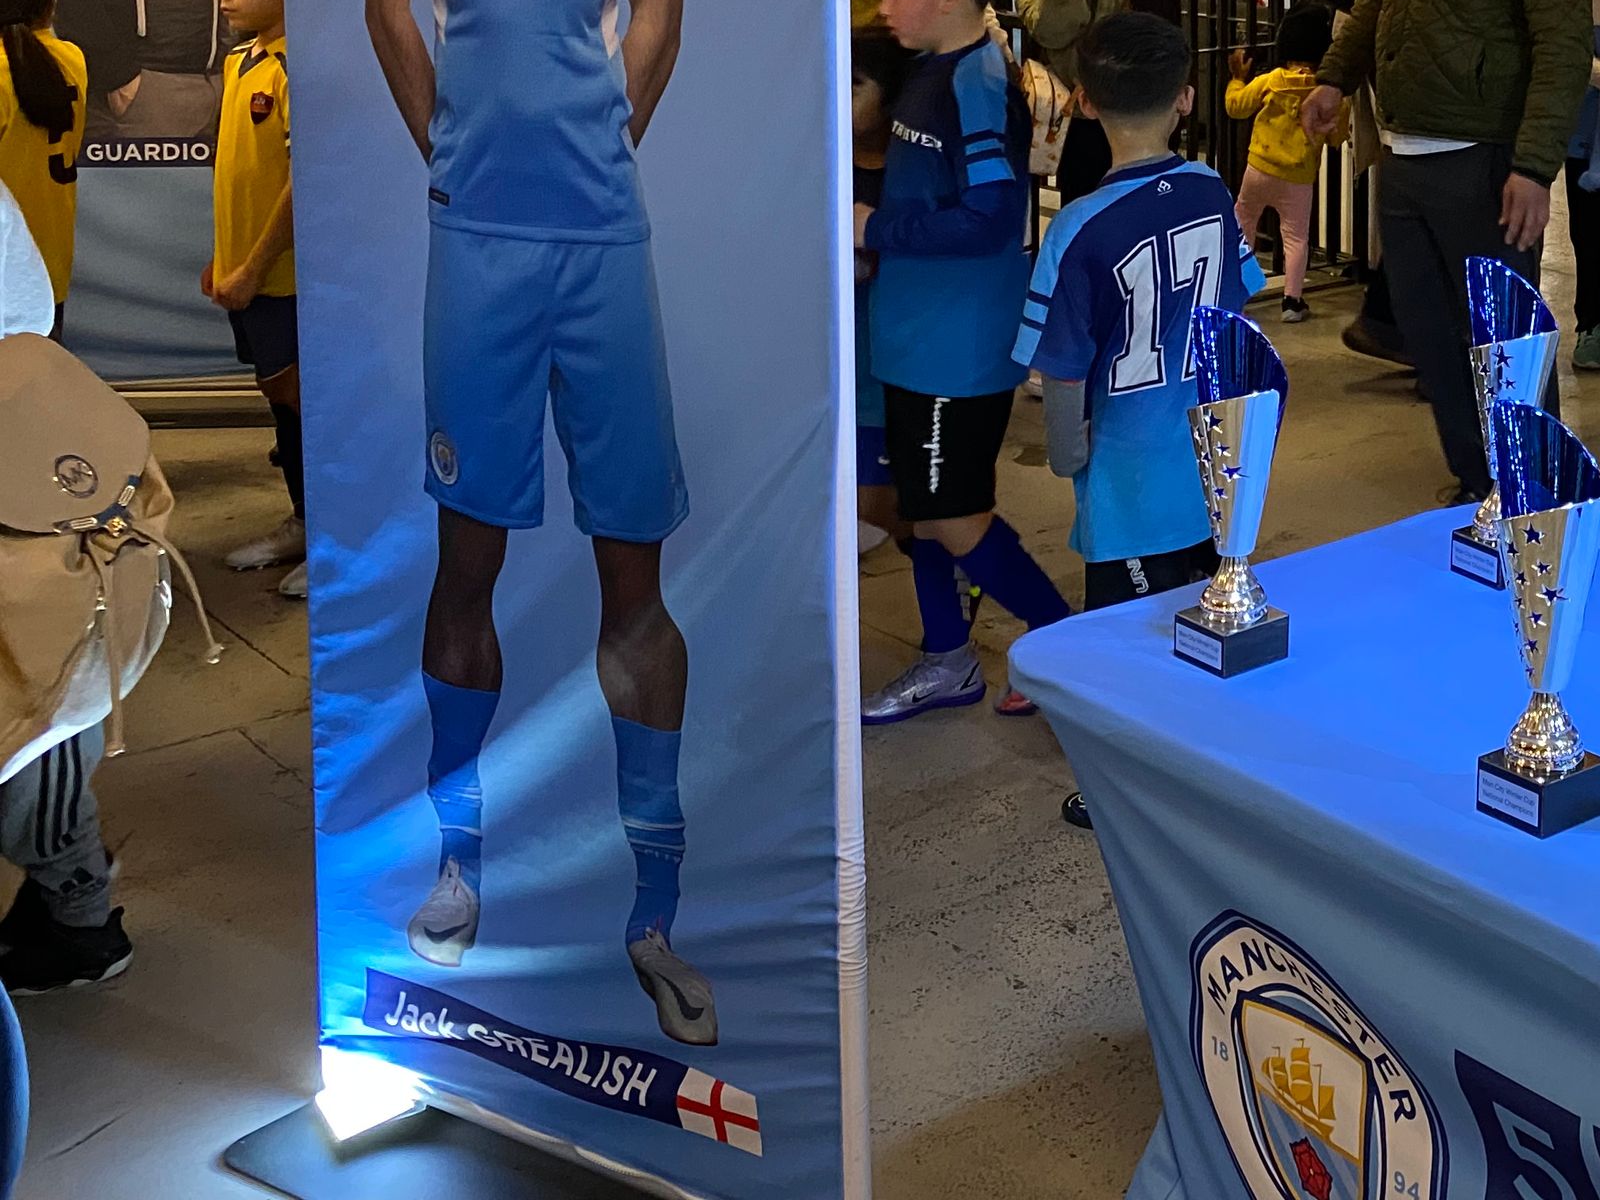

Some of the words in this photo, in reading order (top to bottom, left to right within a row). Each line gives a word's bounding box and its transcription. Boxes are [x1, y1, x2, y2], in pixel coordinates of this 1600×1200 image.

[86, 142, 212, 162] GUARDIO
[1109, 214, 1224, 396] 17
[385, 991, 464, 1041] Jack
[467, 1022, 658, 1107] GREALISH
[1207, 938, 1416, 1124] MANCHESTER
[1211, 1034, 1229, 1062] 18
